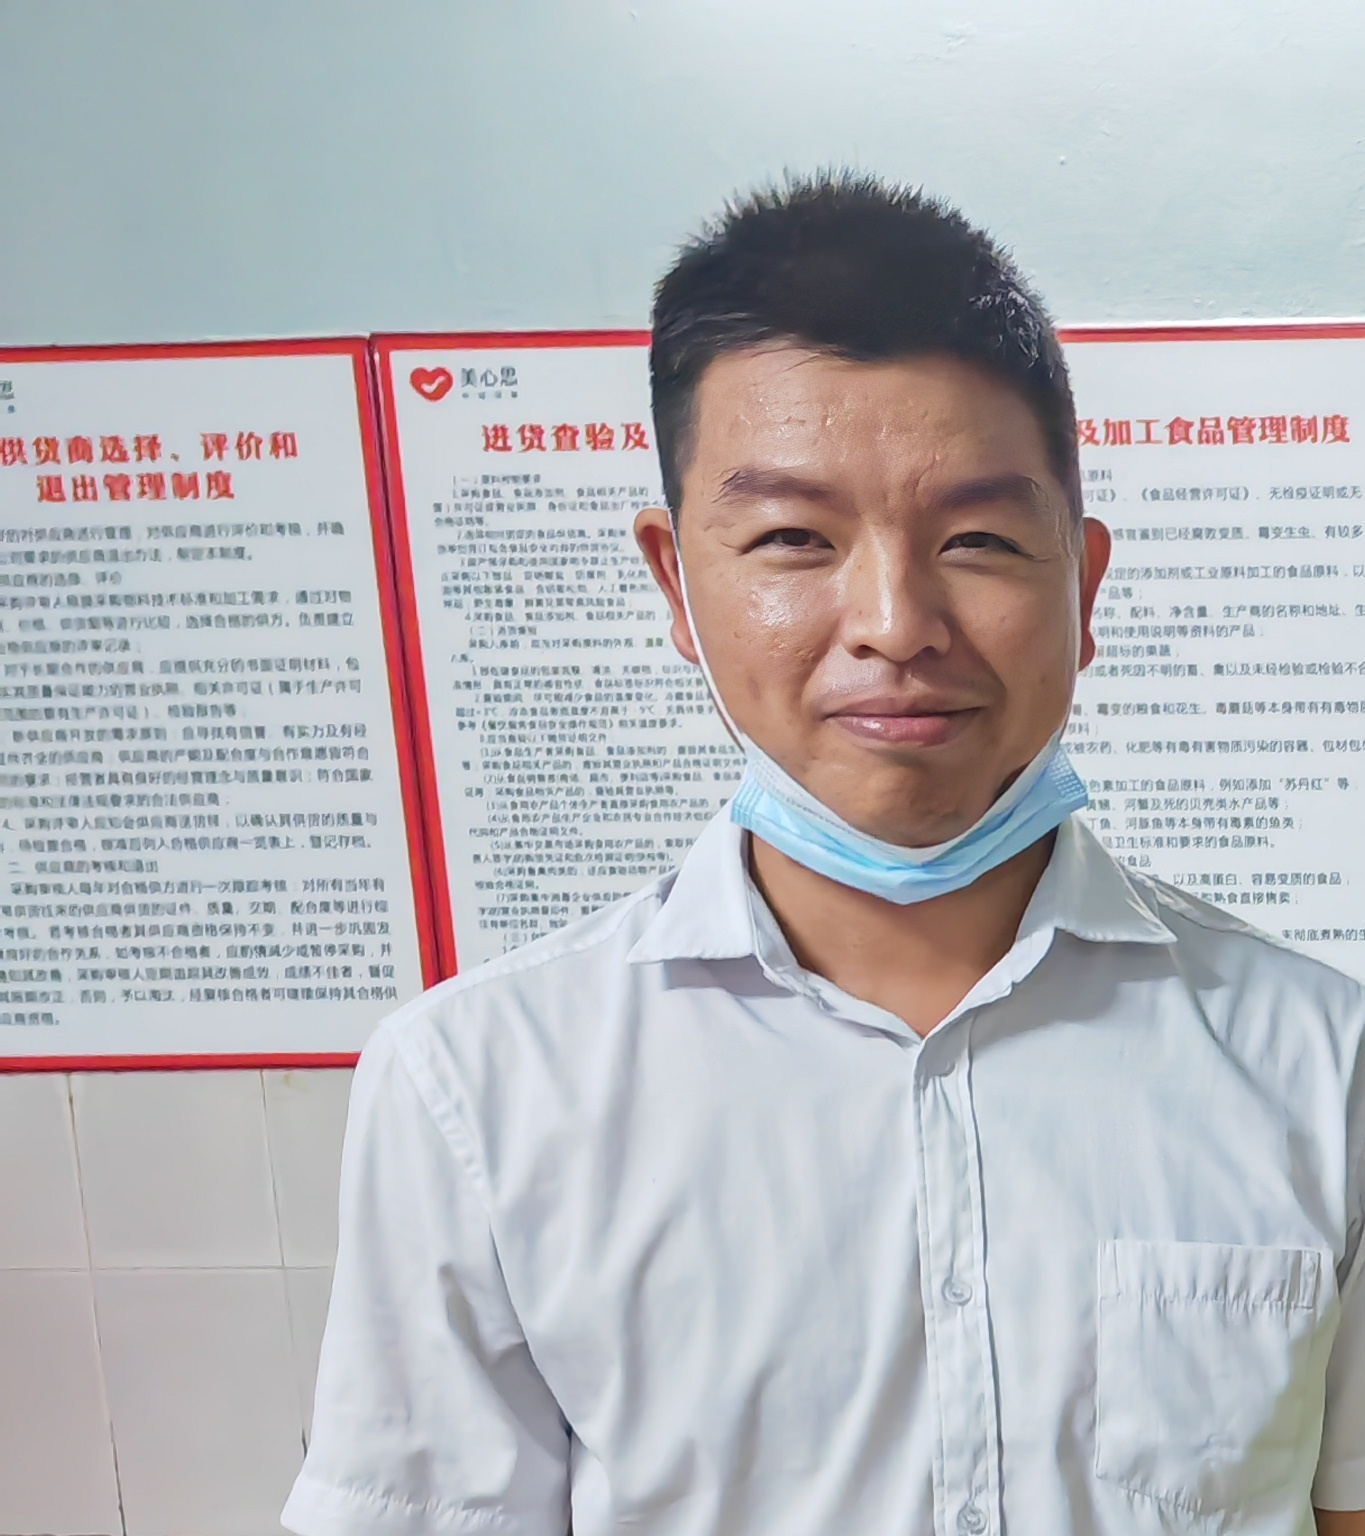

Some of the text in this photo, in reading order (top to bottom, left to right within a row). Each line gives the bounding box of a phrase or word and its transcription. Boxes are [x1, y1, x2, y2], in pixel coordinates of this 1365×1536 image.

[461, 366, 518, 388] 美心思
[482, 422, 649, 452] 进货查验及
[1077, 414, 1351, 446] 及加工食品管理制度
[37, 471, 235, 502] 退出管理制度
